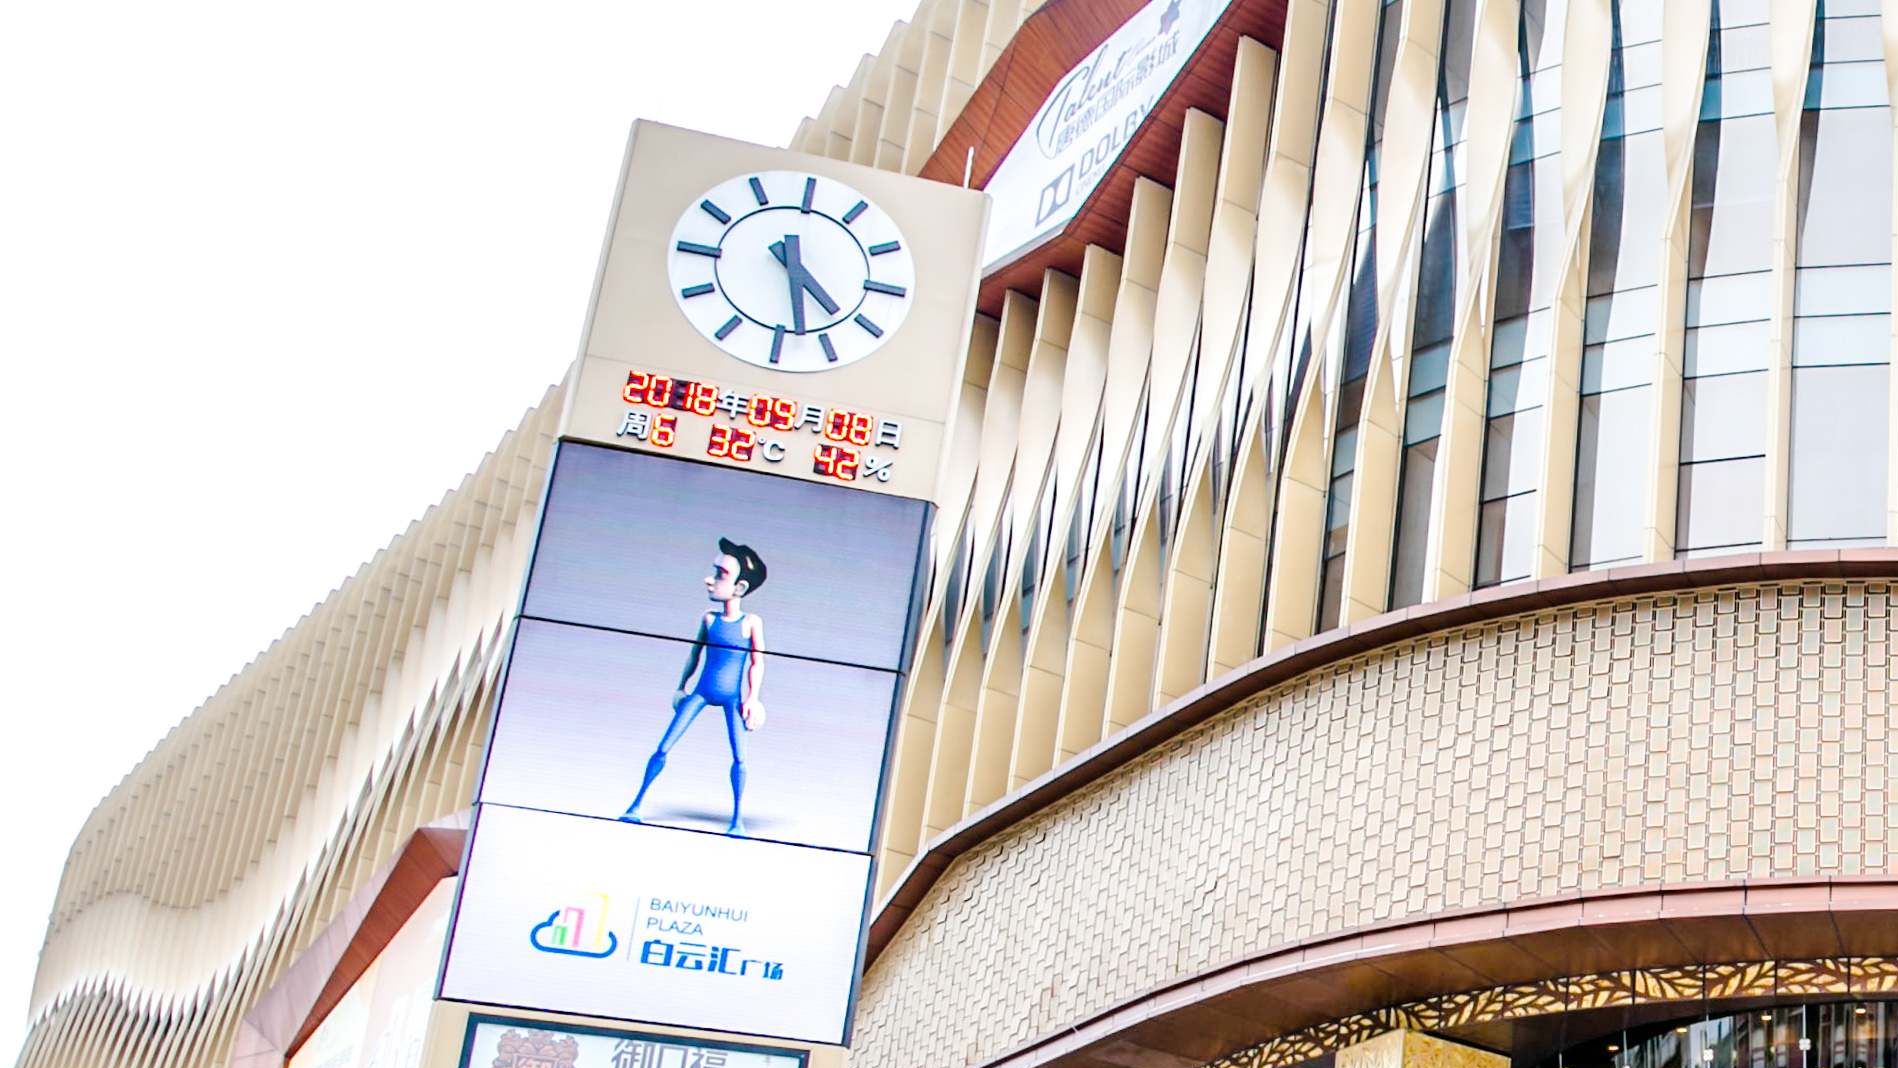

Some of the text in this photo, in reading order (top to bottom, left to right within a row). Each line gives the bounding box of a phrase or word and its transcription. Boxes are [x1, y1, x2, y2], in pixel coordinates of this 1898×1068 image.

[650, 898, 748, 922] BAIYUNHUI
[647, 917, 703, 935] PLAZA
[640, 939, 784, 981] 白云汇广场
